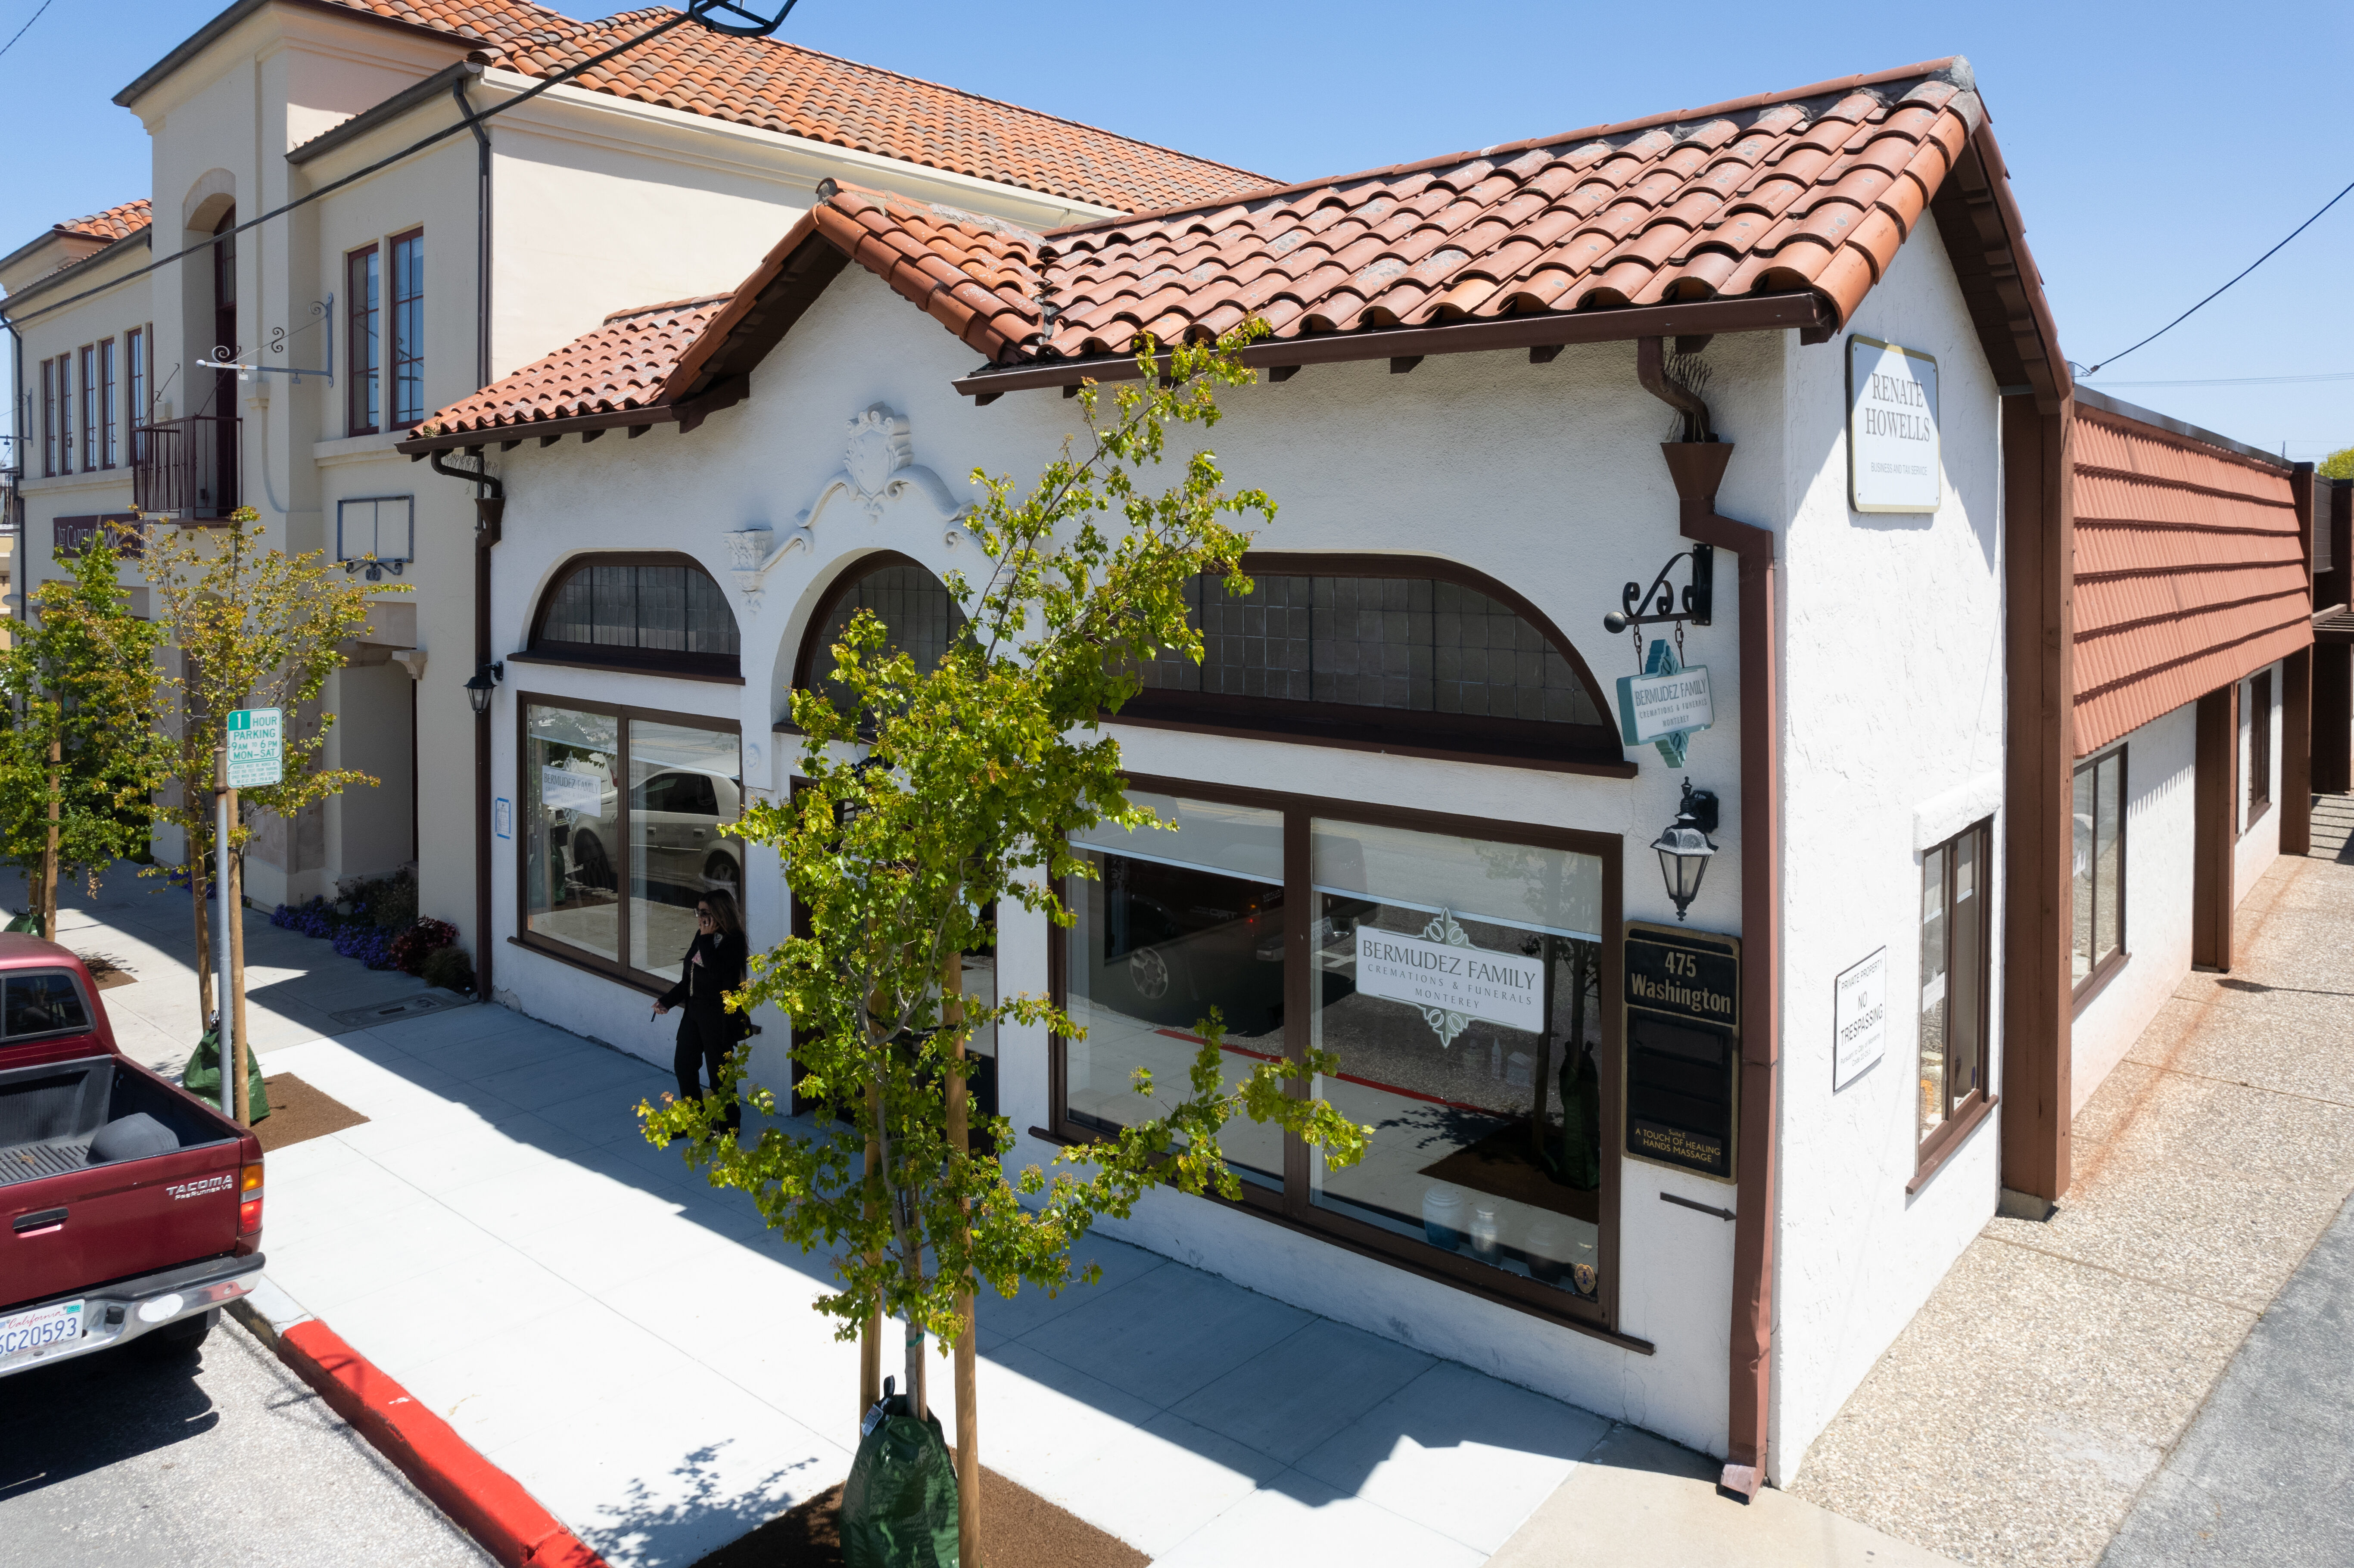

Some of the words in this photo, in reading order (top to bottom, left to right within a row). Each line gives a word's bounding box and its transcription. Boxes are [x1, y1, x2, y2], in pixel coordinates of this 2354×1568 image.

[1872, 373, 1923, 408] RENATE
[1865, 408, 1930, 442] HOWELLS
[1871, 462, 1892, 473] BUSINESS
[1893, 464, 1902, 474] AND
[1912, 466, 1927, 475] SERVICE
[1635, 684, 1679, 706] BERMUDEZ
[1680, 679, 1706, 698] FAMILY
[1640, 706, 1674, 719] CREMATIONS
[1682, 698, 1707, 710] FUNERALS
[237, 713, 241, 729] 1
[253, 716, 277, 726] HOUR
[1663, 715, 1689, 727] MONTEREY
[234, 728, 275, 740] PARKING
[544, 773, 576, 789] BERMUDEZ
[578, 780, 598, 793] FAMILY
[1363, 940, 1461, 976] BERMUDEZ
[1469, 961, 1535, 990] FAMILY
[1665, 952, 1696, 977] 475
[1841, 973, 1859, 992] PRIVATE
[1861, 958, 1883, 983] PROPERTY
[1368, 964, 1444, 986] CREMATIONS
[1453, 982, 1458, 990] &
[1468, 985, 1532, 1005] FUNERALS
[1632, 973, 1731, 1013] Washington
[1415, 988, 1479, 1009] MONTEREY
[1858, 991, 1868, 1011] NO
[1841, 1003, 1883, 1046] TRESPASSING
[1643, 1129, 1670, 1142] TOUCH
[1672, 1137, 1683, 1146] OF
[1686, 1141, 1721, 1156] HEALING
[1669, 1129, 1681, 1137] Suite
[1643, 1139, 1671, 1151] HANDS
[1673, 1146, 1712, 1163] MASSAGE
[165, 1175, 233, 1196] TACOMA
[9, 1311, 68, 1329] California
